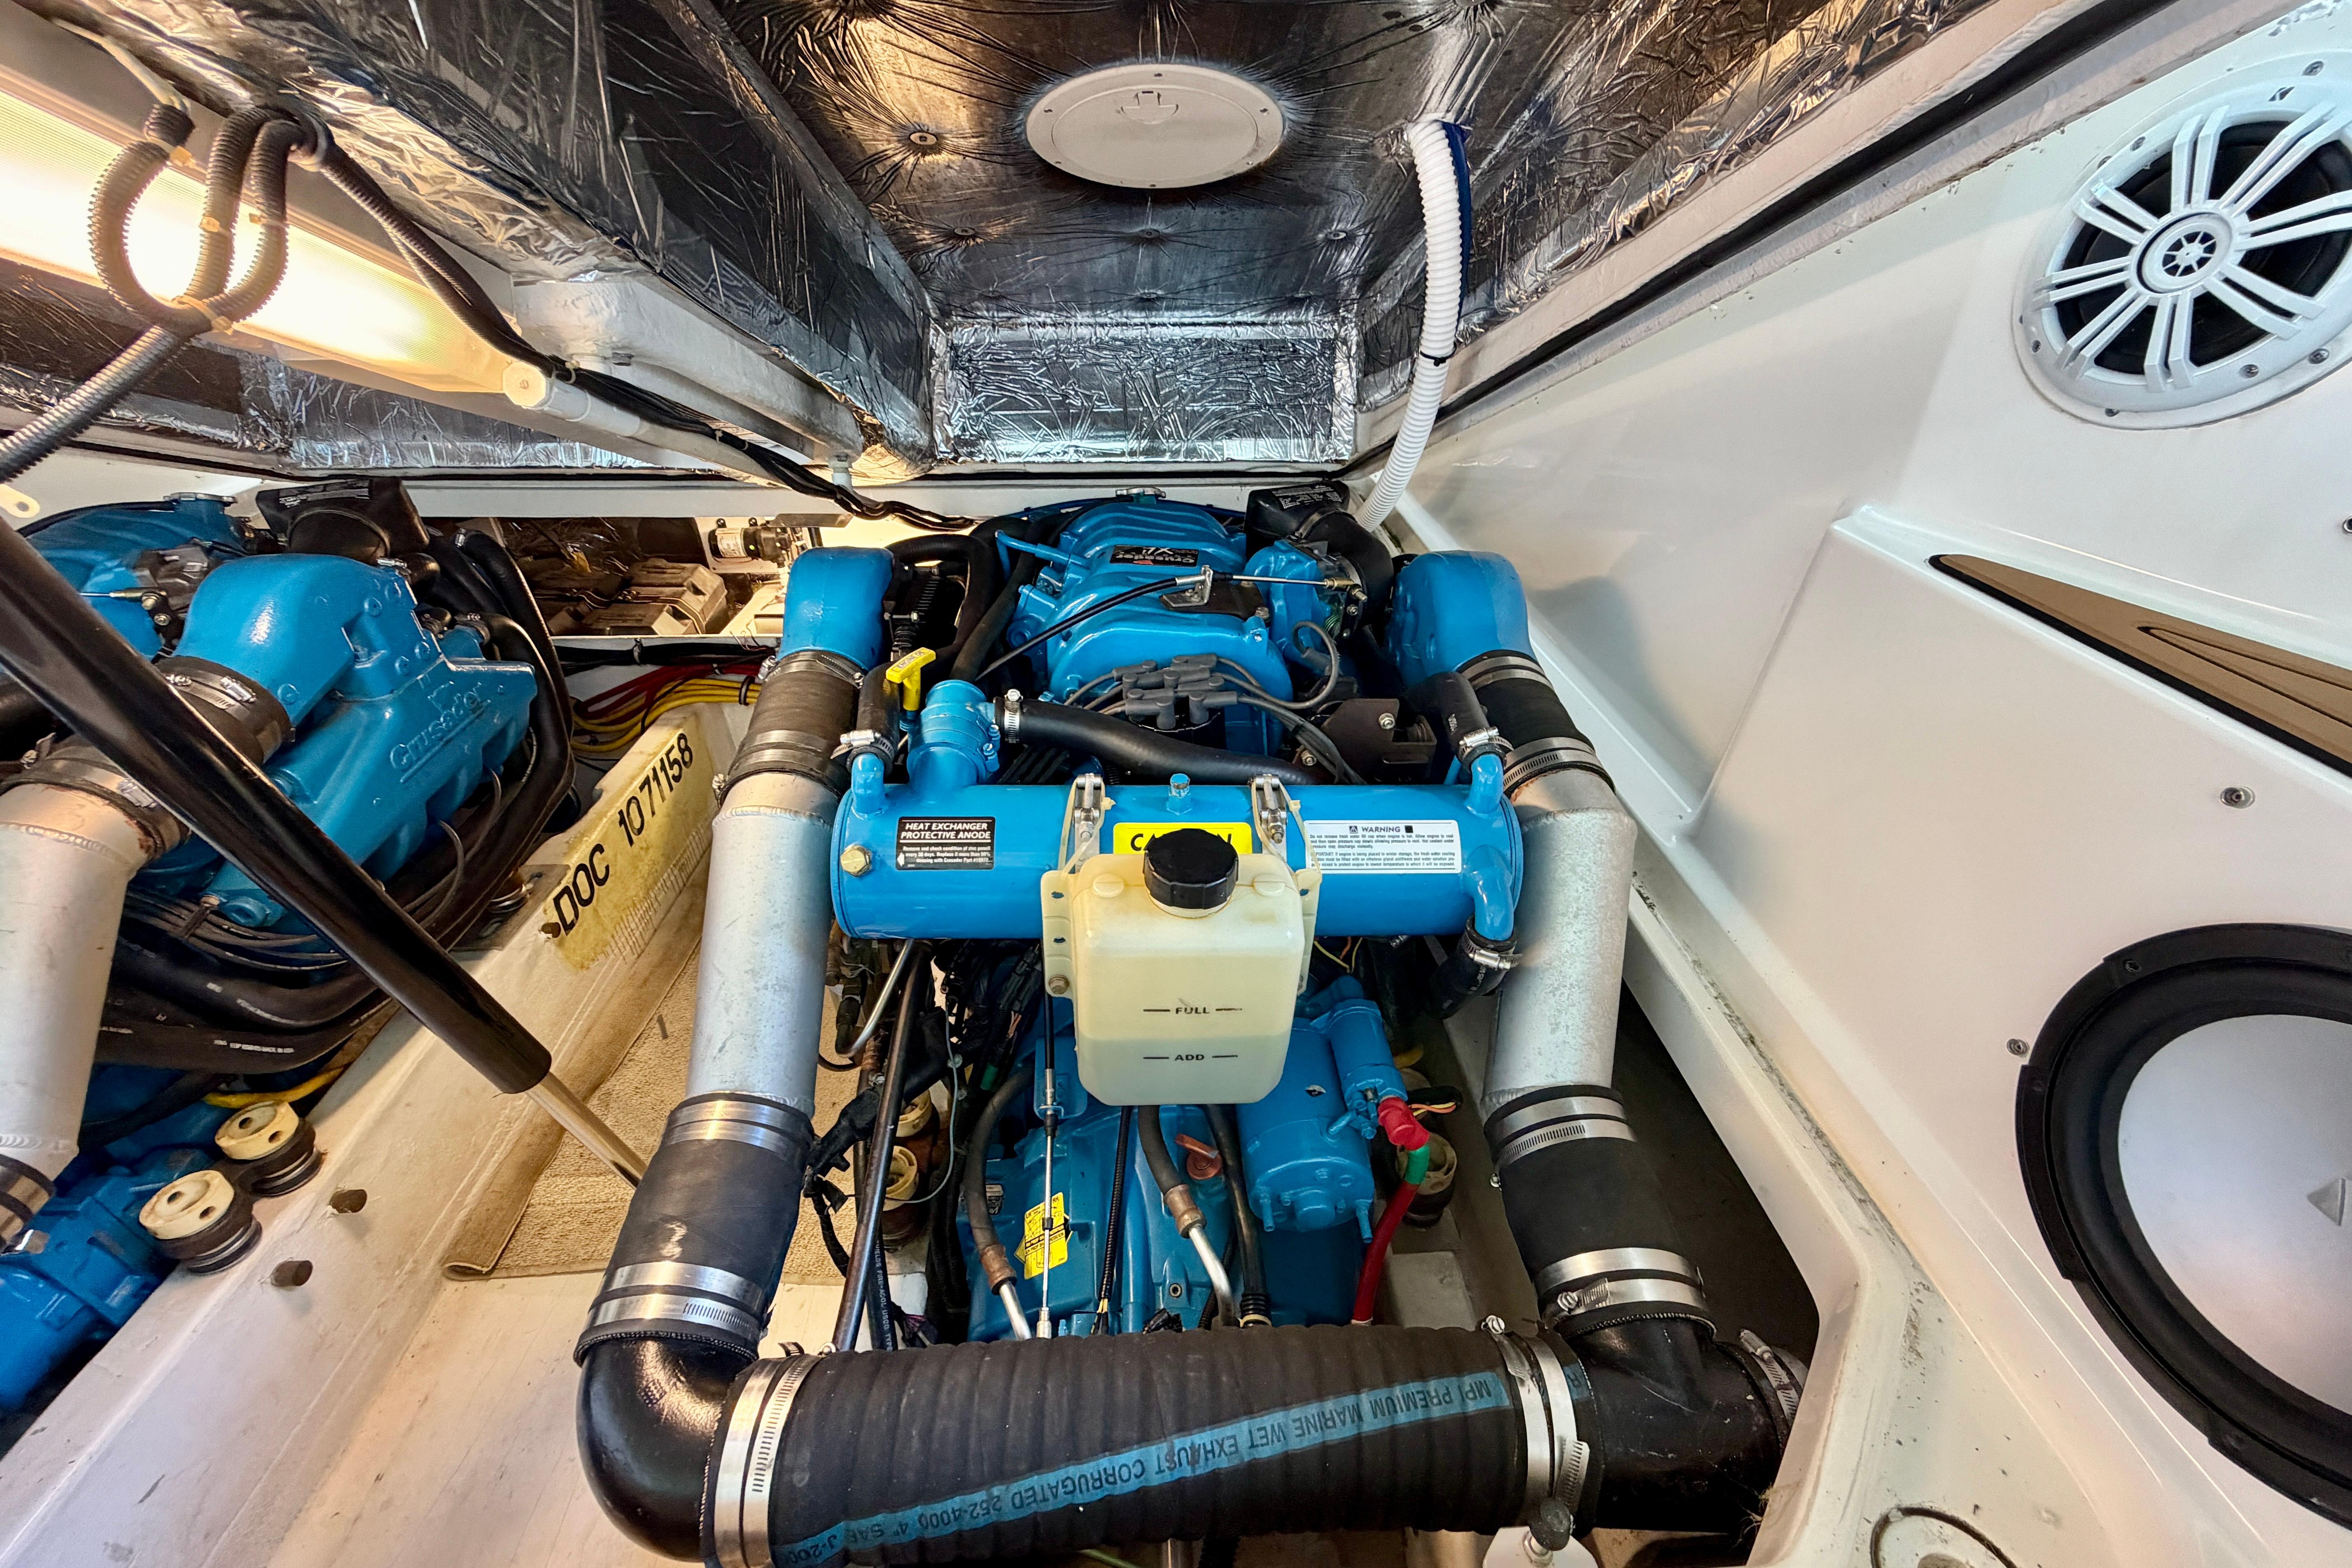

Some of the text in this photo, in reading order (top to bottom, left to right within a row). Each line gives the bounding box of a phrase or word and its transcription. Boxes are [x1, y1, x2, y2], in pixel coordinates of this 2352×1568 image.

[553, 733, 693, 937] DOC 1071158
[1369, 1384, 1452, 1419] PREMIUM
[1458, 1379, 1492, 1400] MPI
[1247, 1422, 1287, 1450] WET
[1291, 1401, 1364, 1439] MARINE
[1154, 1434, 1239, 1476] EXHAUST
[1011, 1458, 1146, 1510] CORRUGATED
[917, 1494, 1003, 1531] 252-4000
